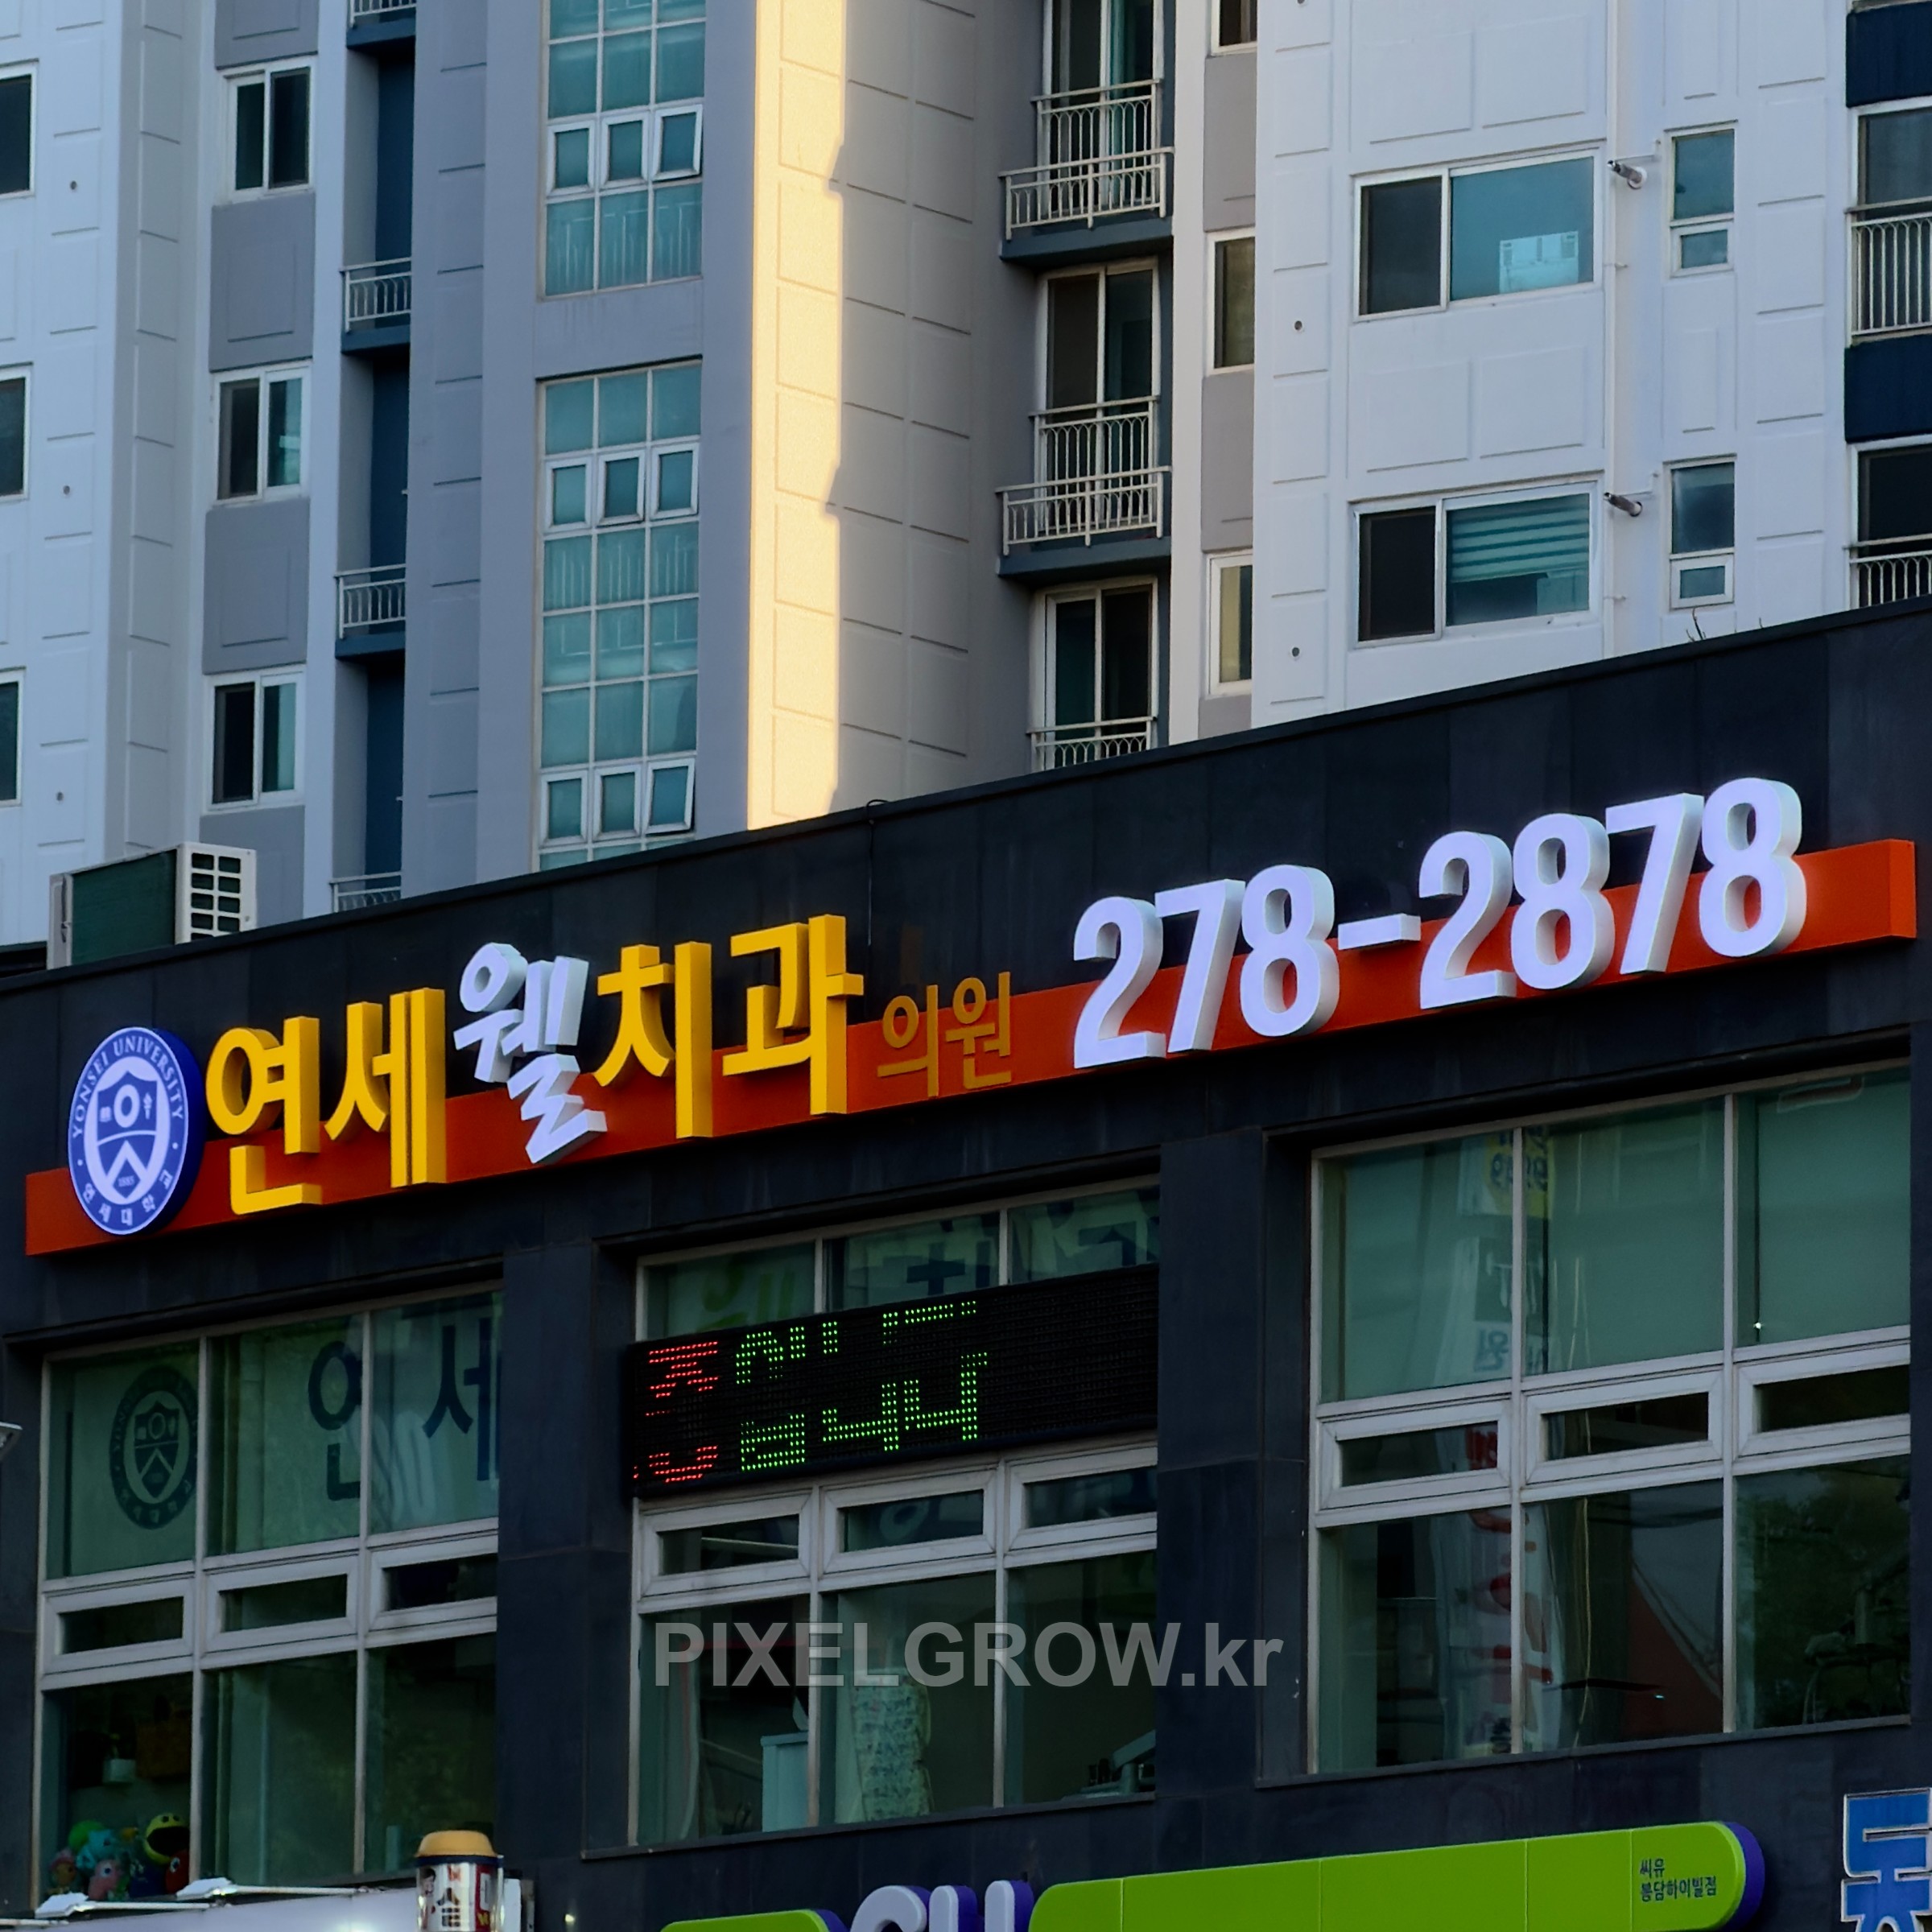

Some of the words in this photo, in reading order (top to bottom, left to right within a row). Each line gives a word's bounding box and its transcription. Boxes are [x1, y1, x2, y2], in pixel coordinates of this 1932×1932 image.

[1073, 777, 1806, 1070] 278-2878
[72, 1051, 109, 1139] YONSEI
[113, 1034, 184, 1120] UNIVERSITY
[1640, 1858, 1665, 1879] 씨유
